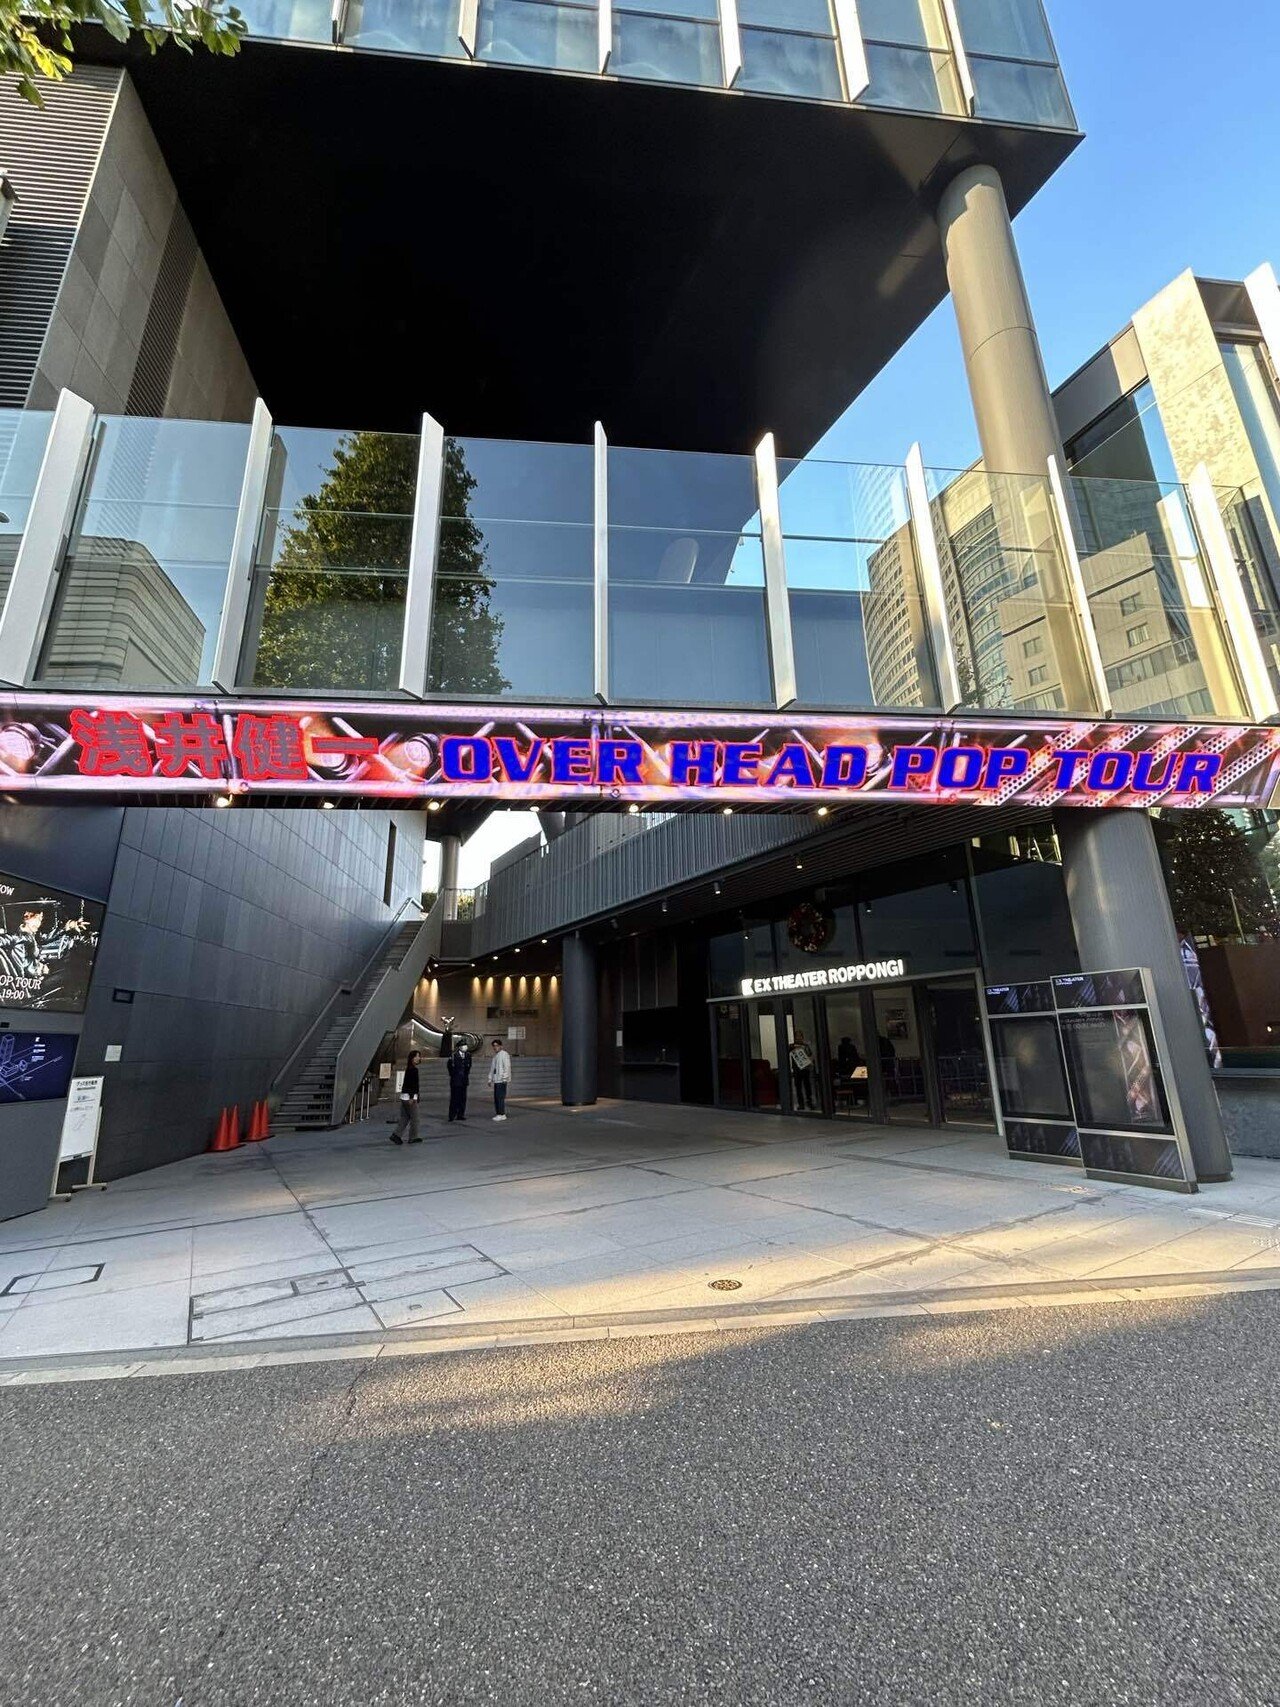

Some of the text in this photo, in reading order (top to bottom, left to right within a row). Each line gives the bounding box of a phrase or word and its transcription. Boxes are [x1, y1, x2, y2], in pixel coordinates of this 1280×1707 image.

[70, 709, 1224, 794] 浅井健一 OVER HEAD POP TOUR
[15, 977, 43, 990] TOUR
[754, 959, 904, 992] EX THEATER ROPPONGI
